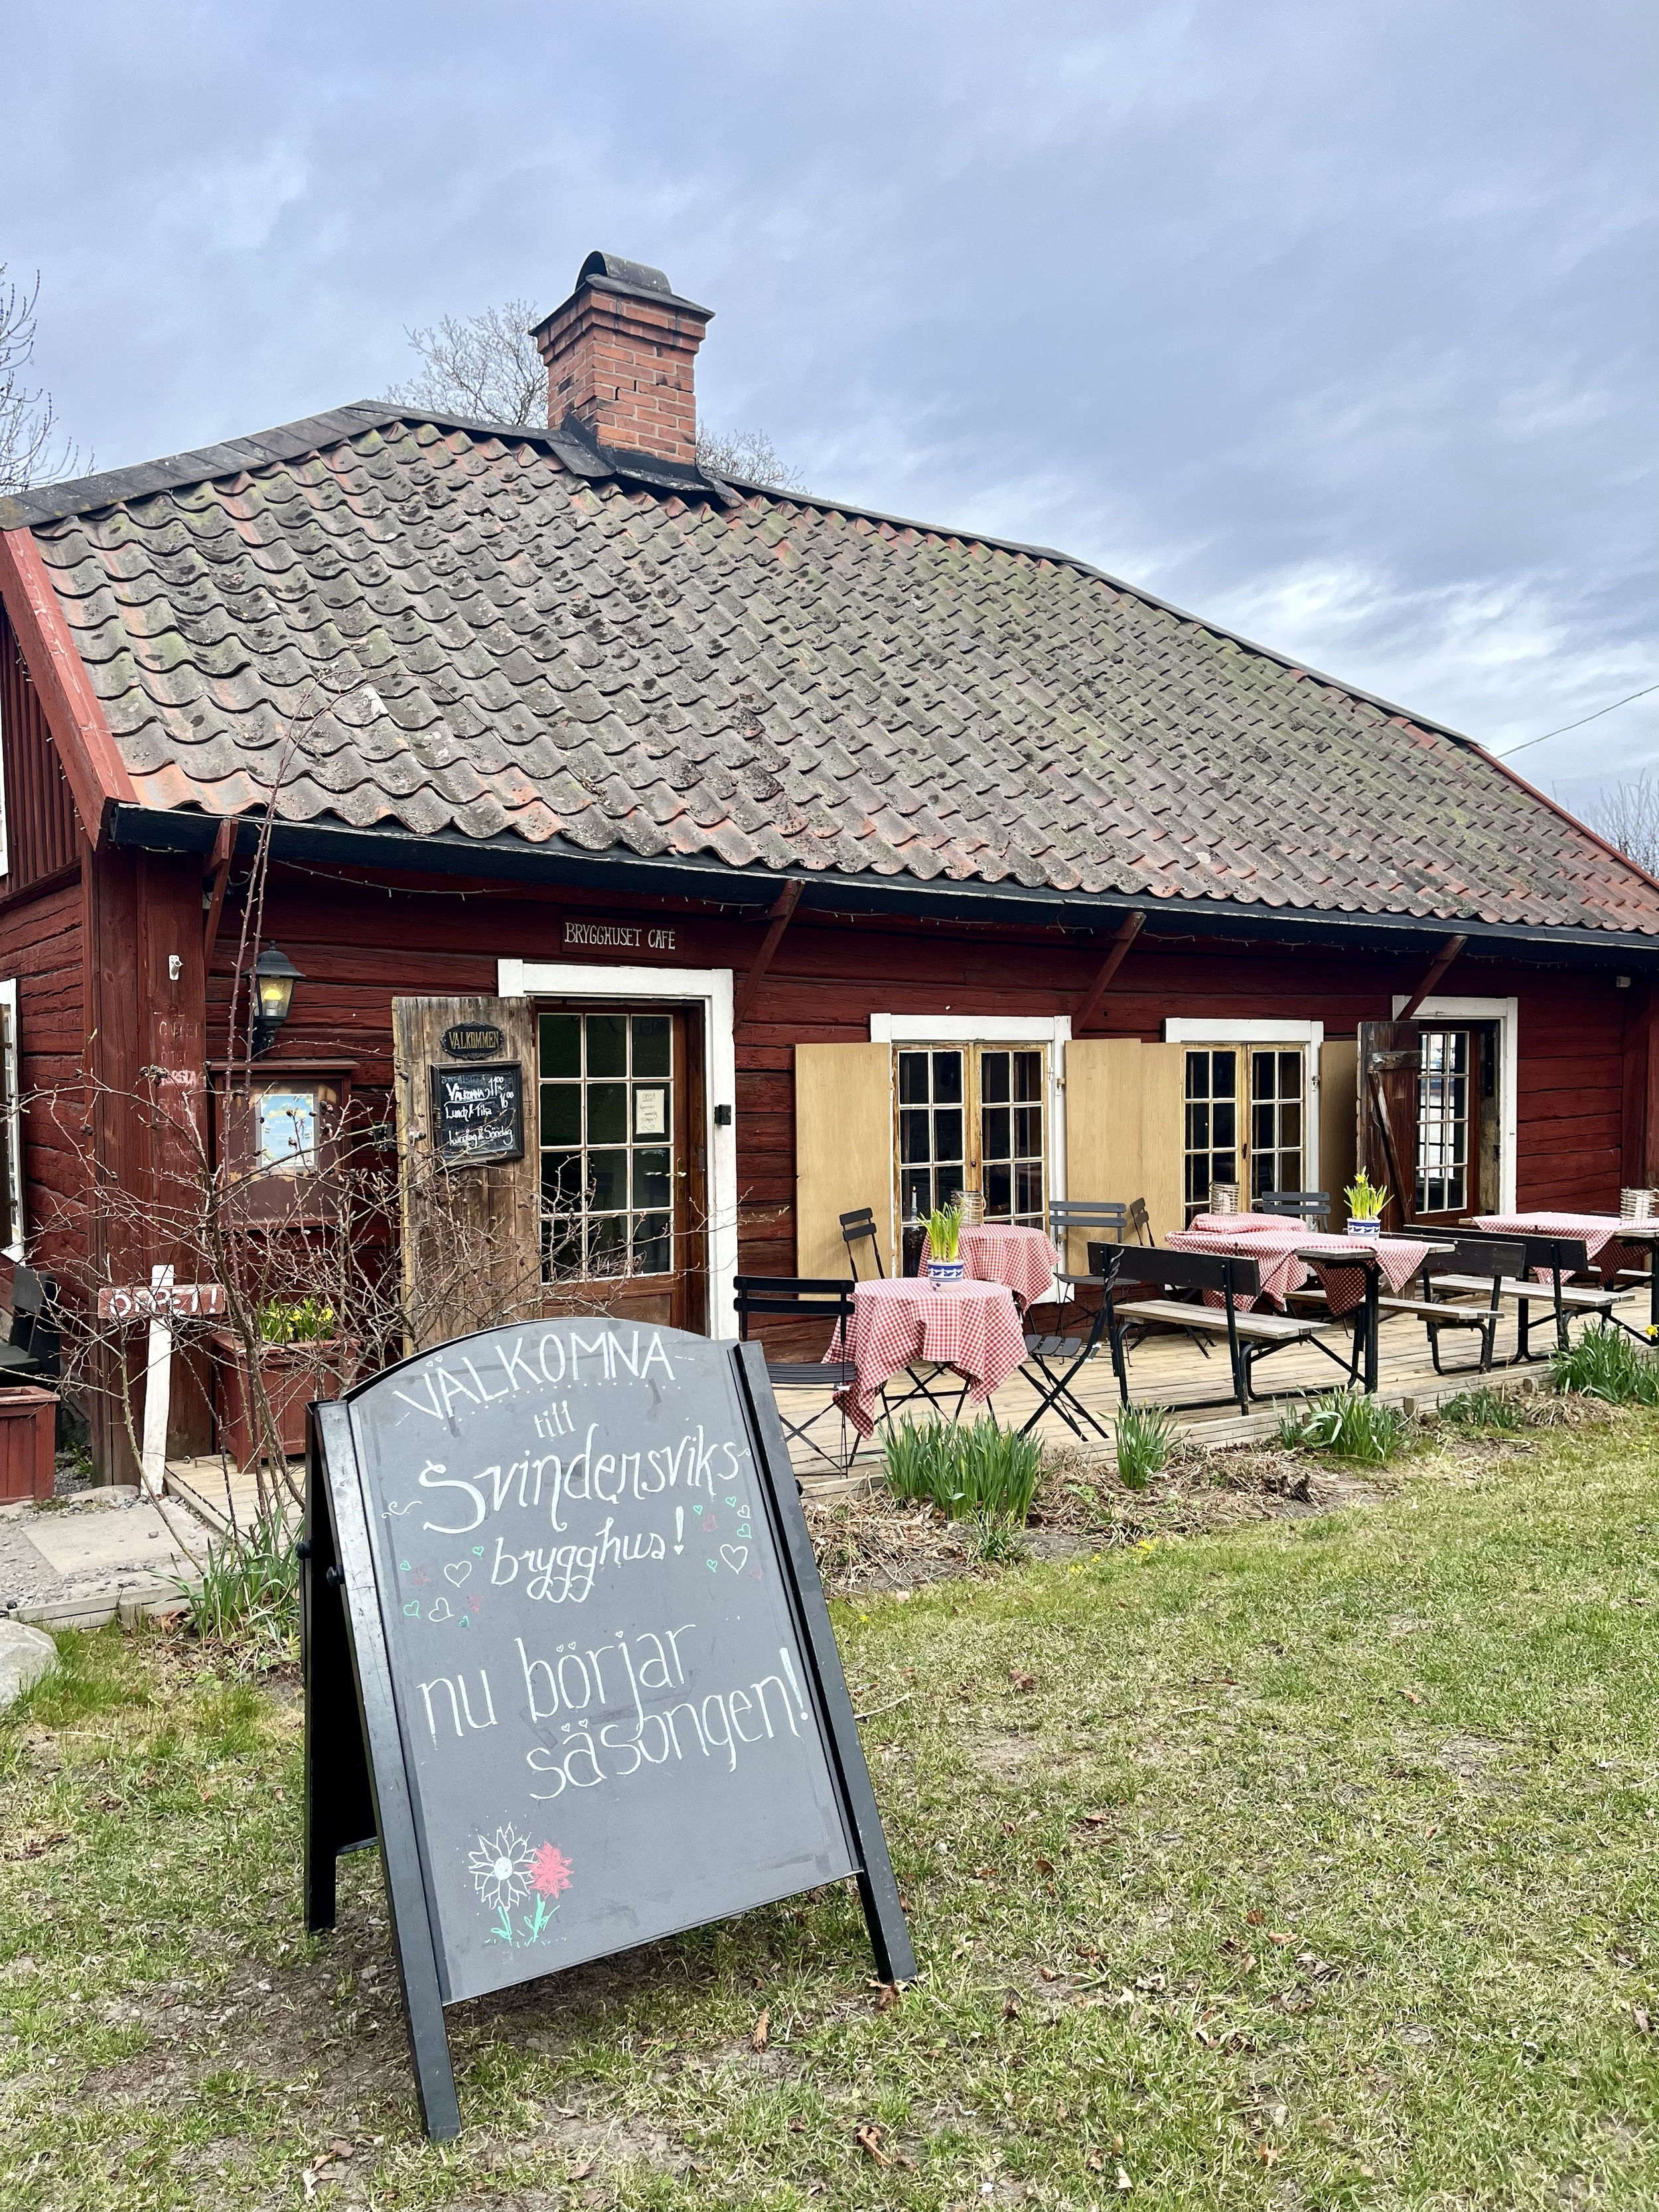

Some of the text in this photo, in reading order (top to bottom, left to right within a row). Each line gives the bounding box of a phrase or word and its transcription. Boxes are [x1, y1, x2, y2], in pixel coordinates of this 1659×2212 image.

[565, 922, 676, 950] BRYGGHUSET CAFÉ
[448, 1030, 499, 1049] VÄLKOMMEN
[445, 1106, 469, 1122] Lunch
[484, 1125, 512, 1145] Söndag
[392, 1330, 676, 1420] VÄLKOMNA
[534, 1400, 577, 1439] till
[419, 1423, 739, 1534] Svindersviks
[491, 1505, 685, 1603] brygghus!
[416, 1624, 697, 1751] nu börjar
[526, 1647, 809, 1801] säsongen!
